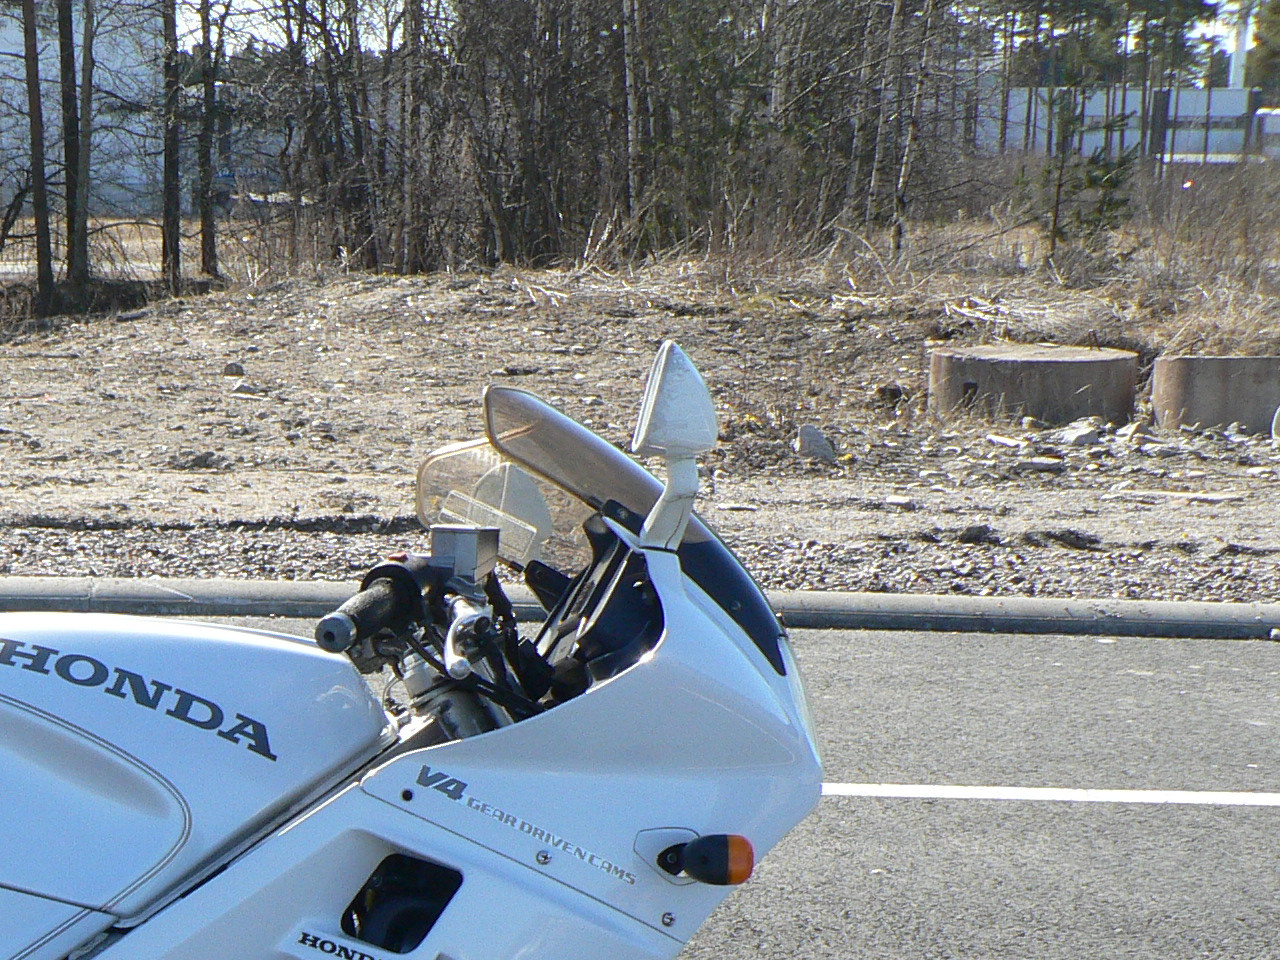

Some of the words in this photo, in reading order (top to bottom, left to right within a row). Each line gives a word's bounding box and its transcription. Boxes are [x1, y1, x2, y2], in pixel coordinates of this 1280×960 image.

[416, 764, 468, 800] V4
[467, 797, 517, 827] GEAR
[519, 820, 588, 860] DRIVEN
[587, 854, 637, 885] CAMS
